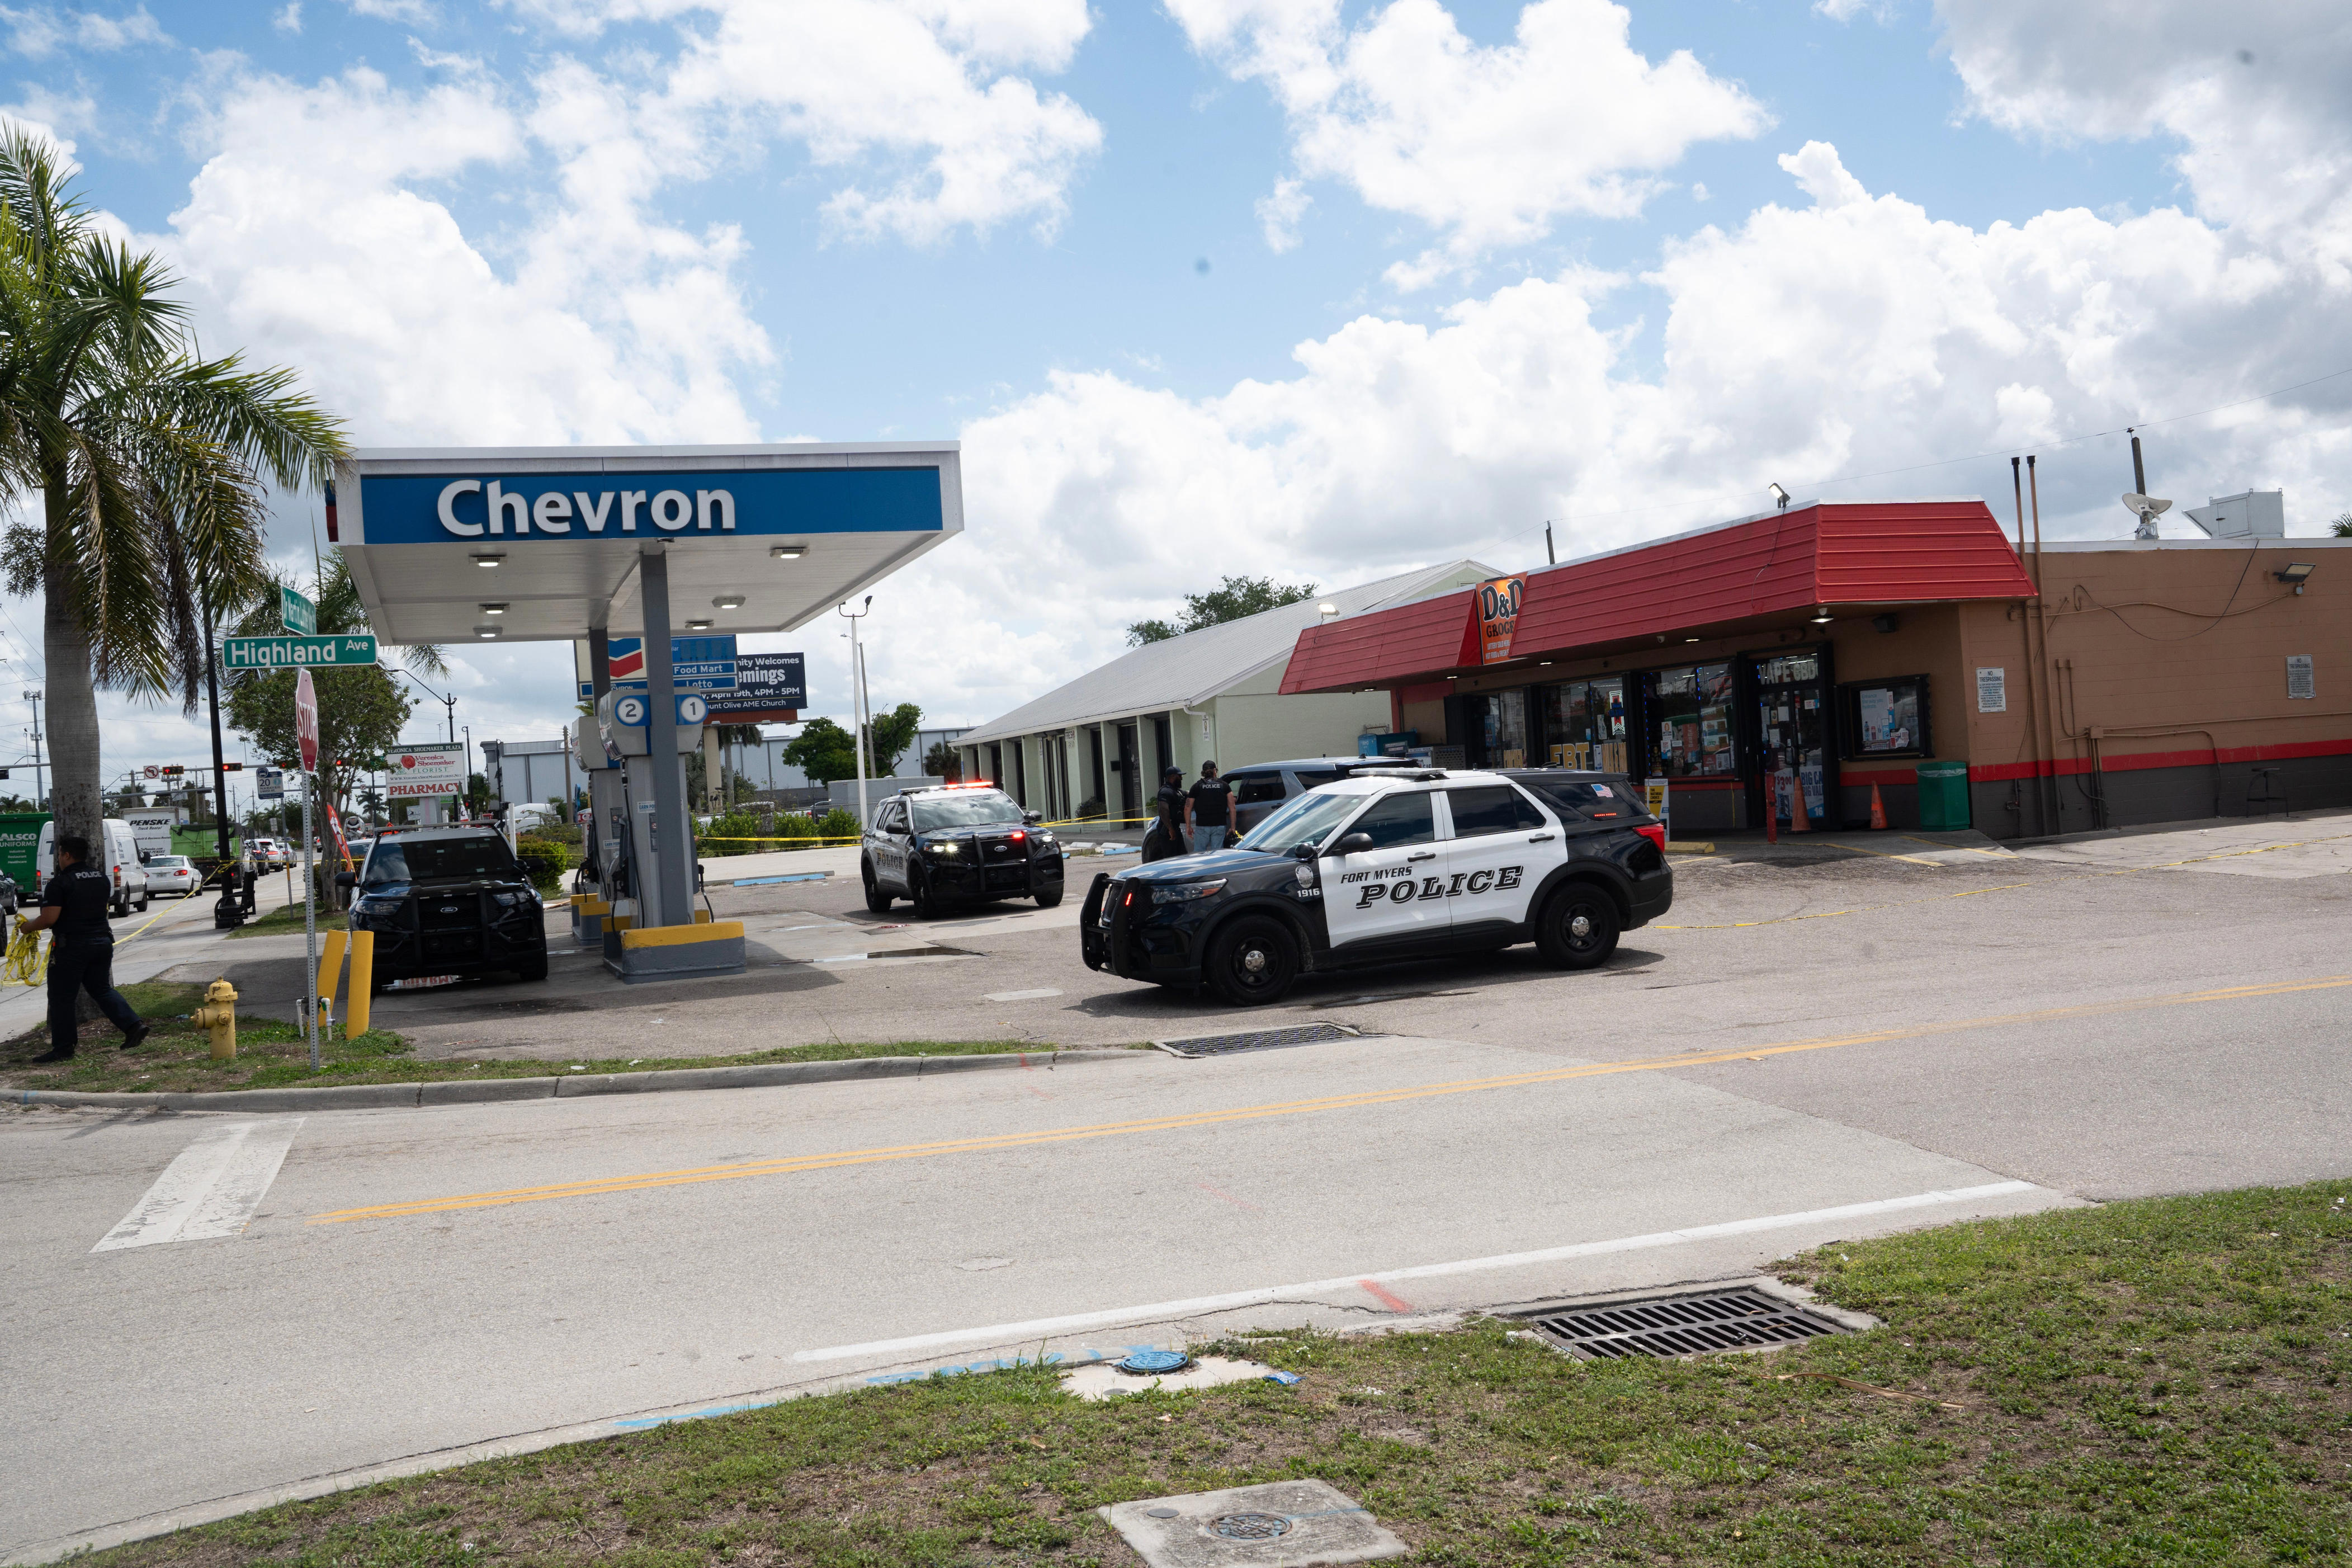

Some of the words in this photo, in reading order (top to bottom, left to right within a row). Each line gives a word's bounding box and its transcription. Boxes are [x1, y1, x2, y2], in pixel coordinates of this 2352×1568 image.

[437, 479, 736, 537] Chevron
[1480, 578, 1525, 622] D&D
[232, 640, 336, 667] Highland
[346, 639, 369, 651] Ave
[755, 657, 799, 665] Welcomes
[674, 665, 697, 674] Food
[700, 664, 722, 673] Mart
[739, 667, 786, 685] emings
[1758, 660, 1791, 685] VAPE
[625, 703, 637, 717] 2
[689, 702, 696, 716] 1
[298, 701, 316, 741] STOP
[1550, 742, 1589, 770] EBT
[1801, 771, 1812, 786] BIG
[389, 782, 462, 796] PHARMACY
[877, 852, 903, 870] POLICE
[75, 871, 102, 879] POLICE
[1340, 871, 1371, 884] FORT
[1373, 866, 1413, 880] MYERS
[1297, 888, 1320, 898] 1916
[1356, 865, 1524, 909] POLICE
